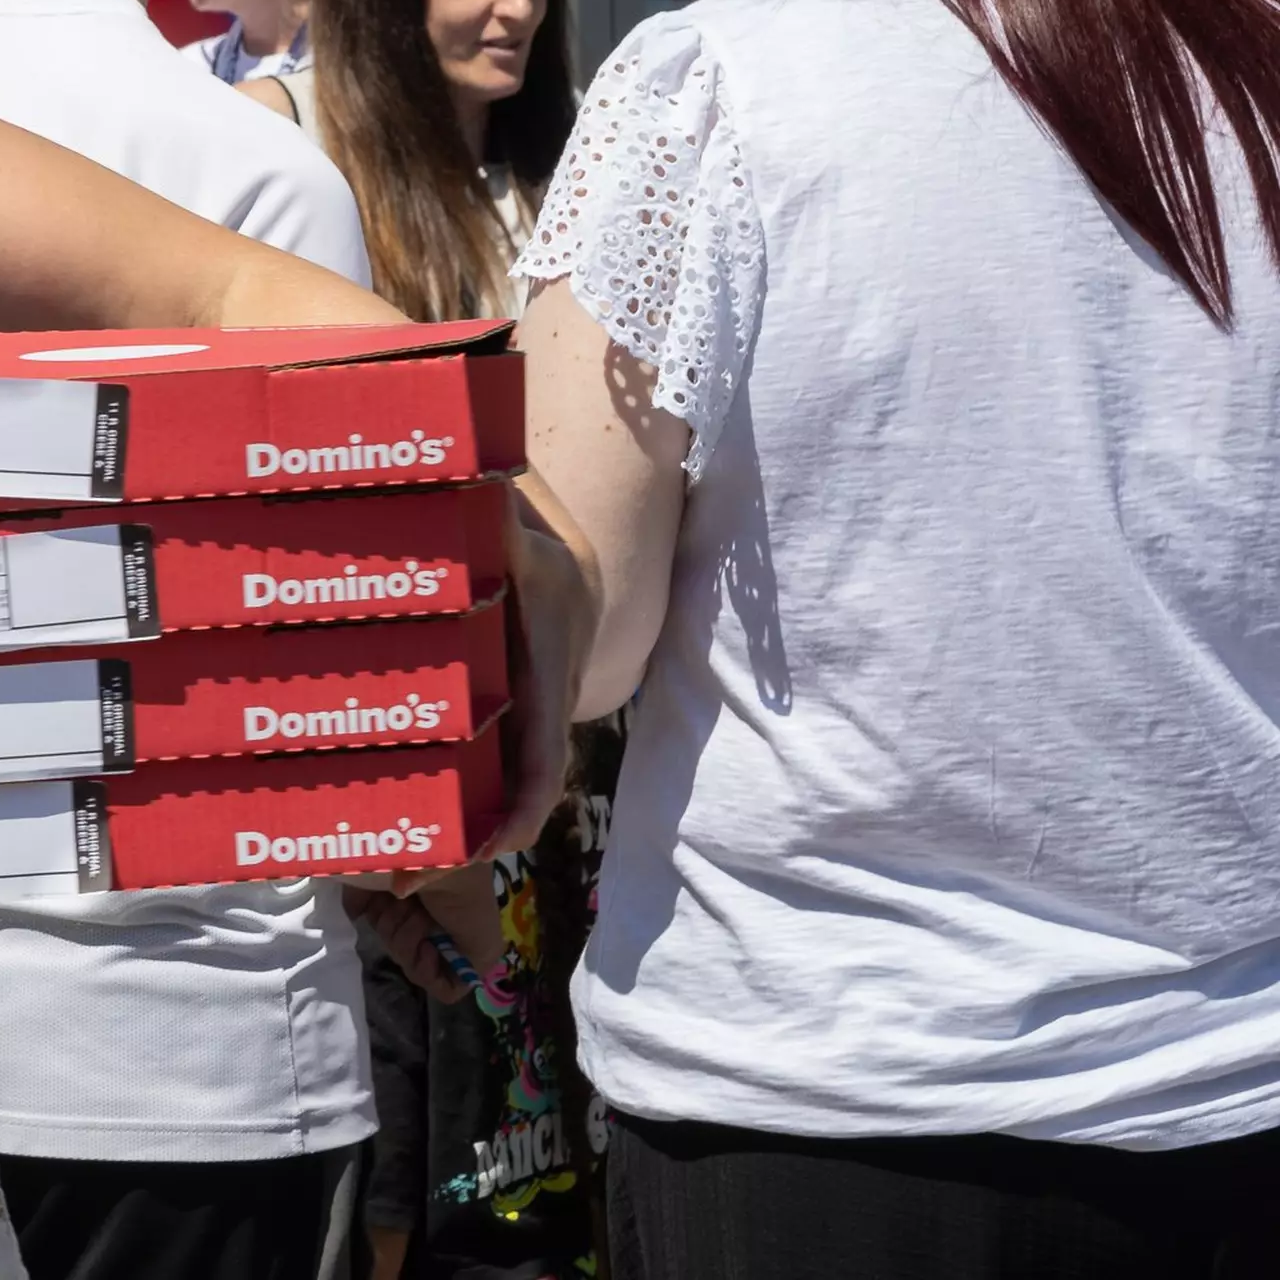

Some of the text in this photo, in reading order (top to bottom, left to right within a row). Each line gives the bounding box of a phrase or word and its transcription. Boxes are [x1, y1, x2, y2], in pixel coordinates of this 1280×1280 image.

[103, 429, 118, 482] ORIGINAL
[135, 568, 150, 621] ORIGINAL
[113, 704, 126, 756] ORIGINAL
[87, 824, 100, 879] ORIGINAL
